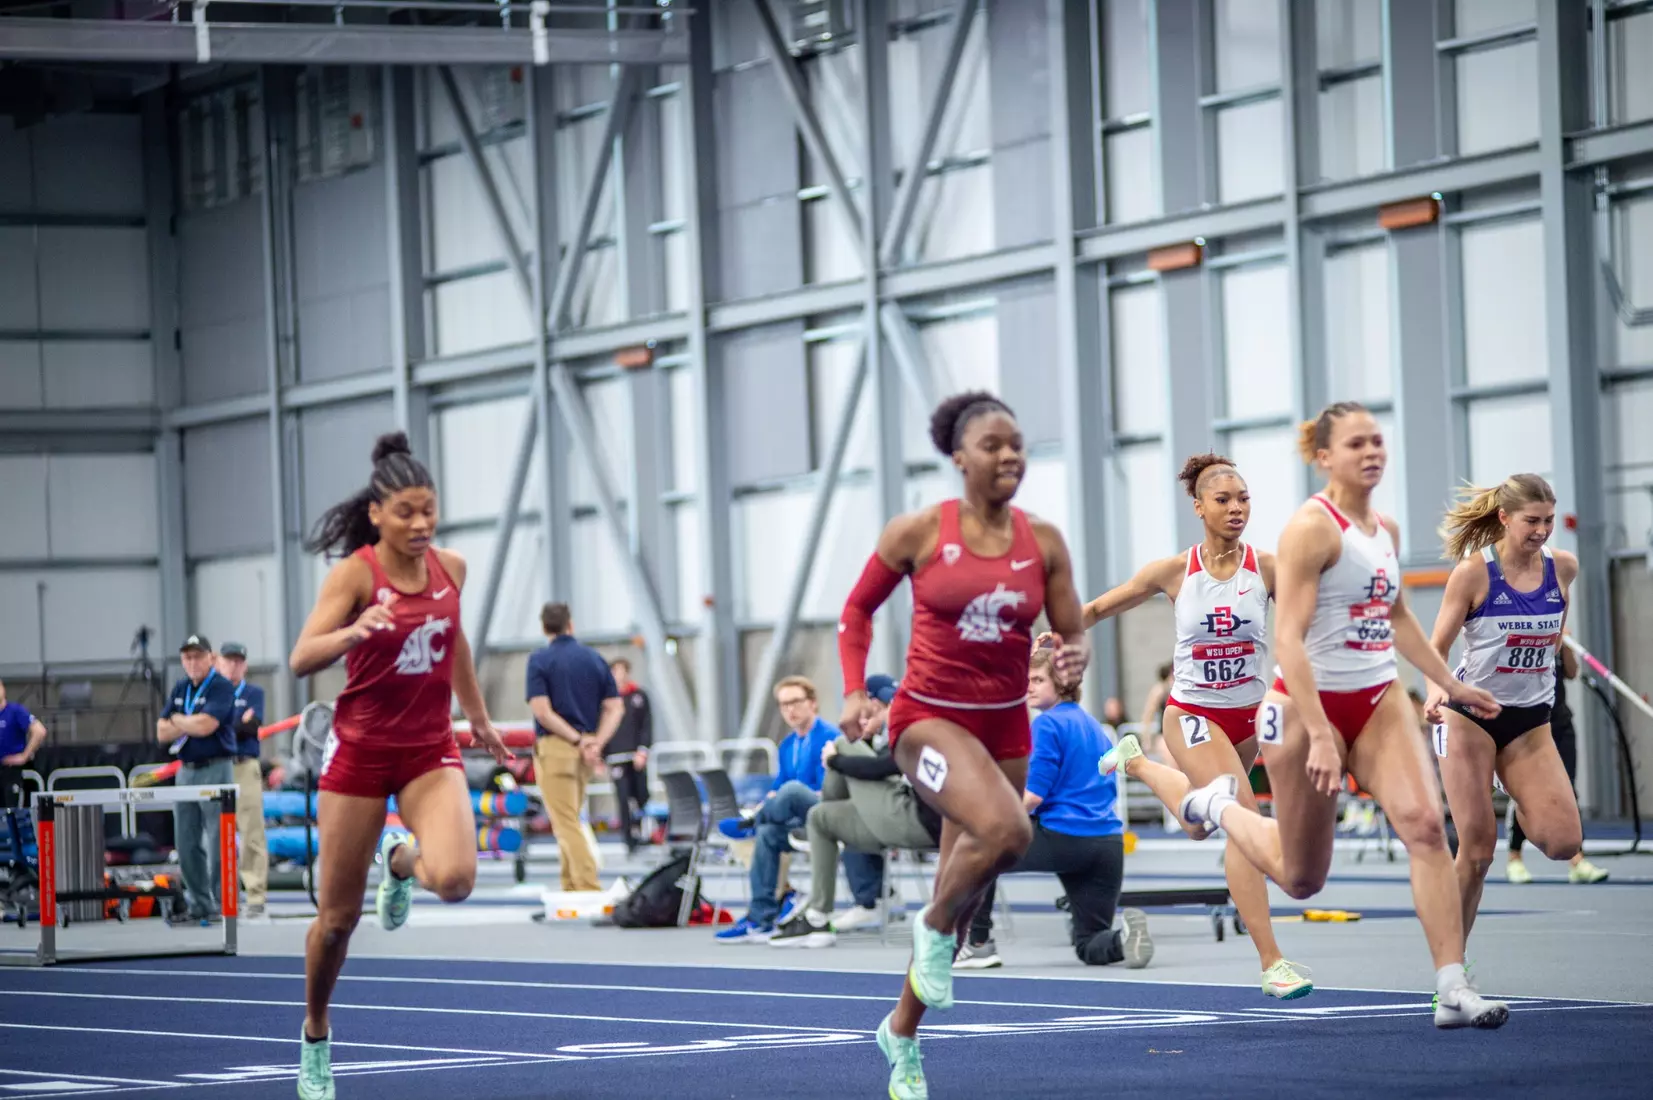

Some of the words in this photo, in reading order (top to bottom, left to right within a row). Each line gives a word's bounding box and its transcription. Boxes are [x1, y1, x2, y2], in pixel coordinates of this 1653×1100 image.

[1498, 621, 1533, 630] WEBER
[1538, 619, 1559, 629] STATE
[1206, 647, 1223, 657] WSU
[1225, 646, 1243, 656] OPEN
[1508, 647, 1546, 668] 888
[1203, 657, 1246, 682] 662
[1185, 715, 1206, 745] 2
[1264, 706, 1277, 740] 3
[1436, 725, 1443, 754] 1
[923, 757, 944, 782] 4
